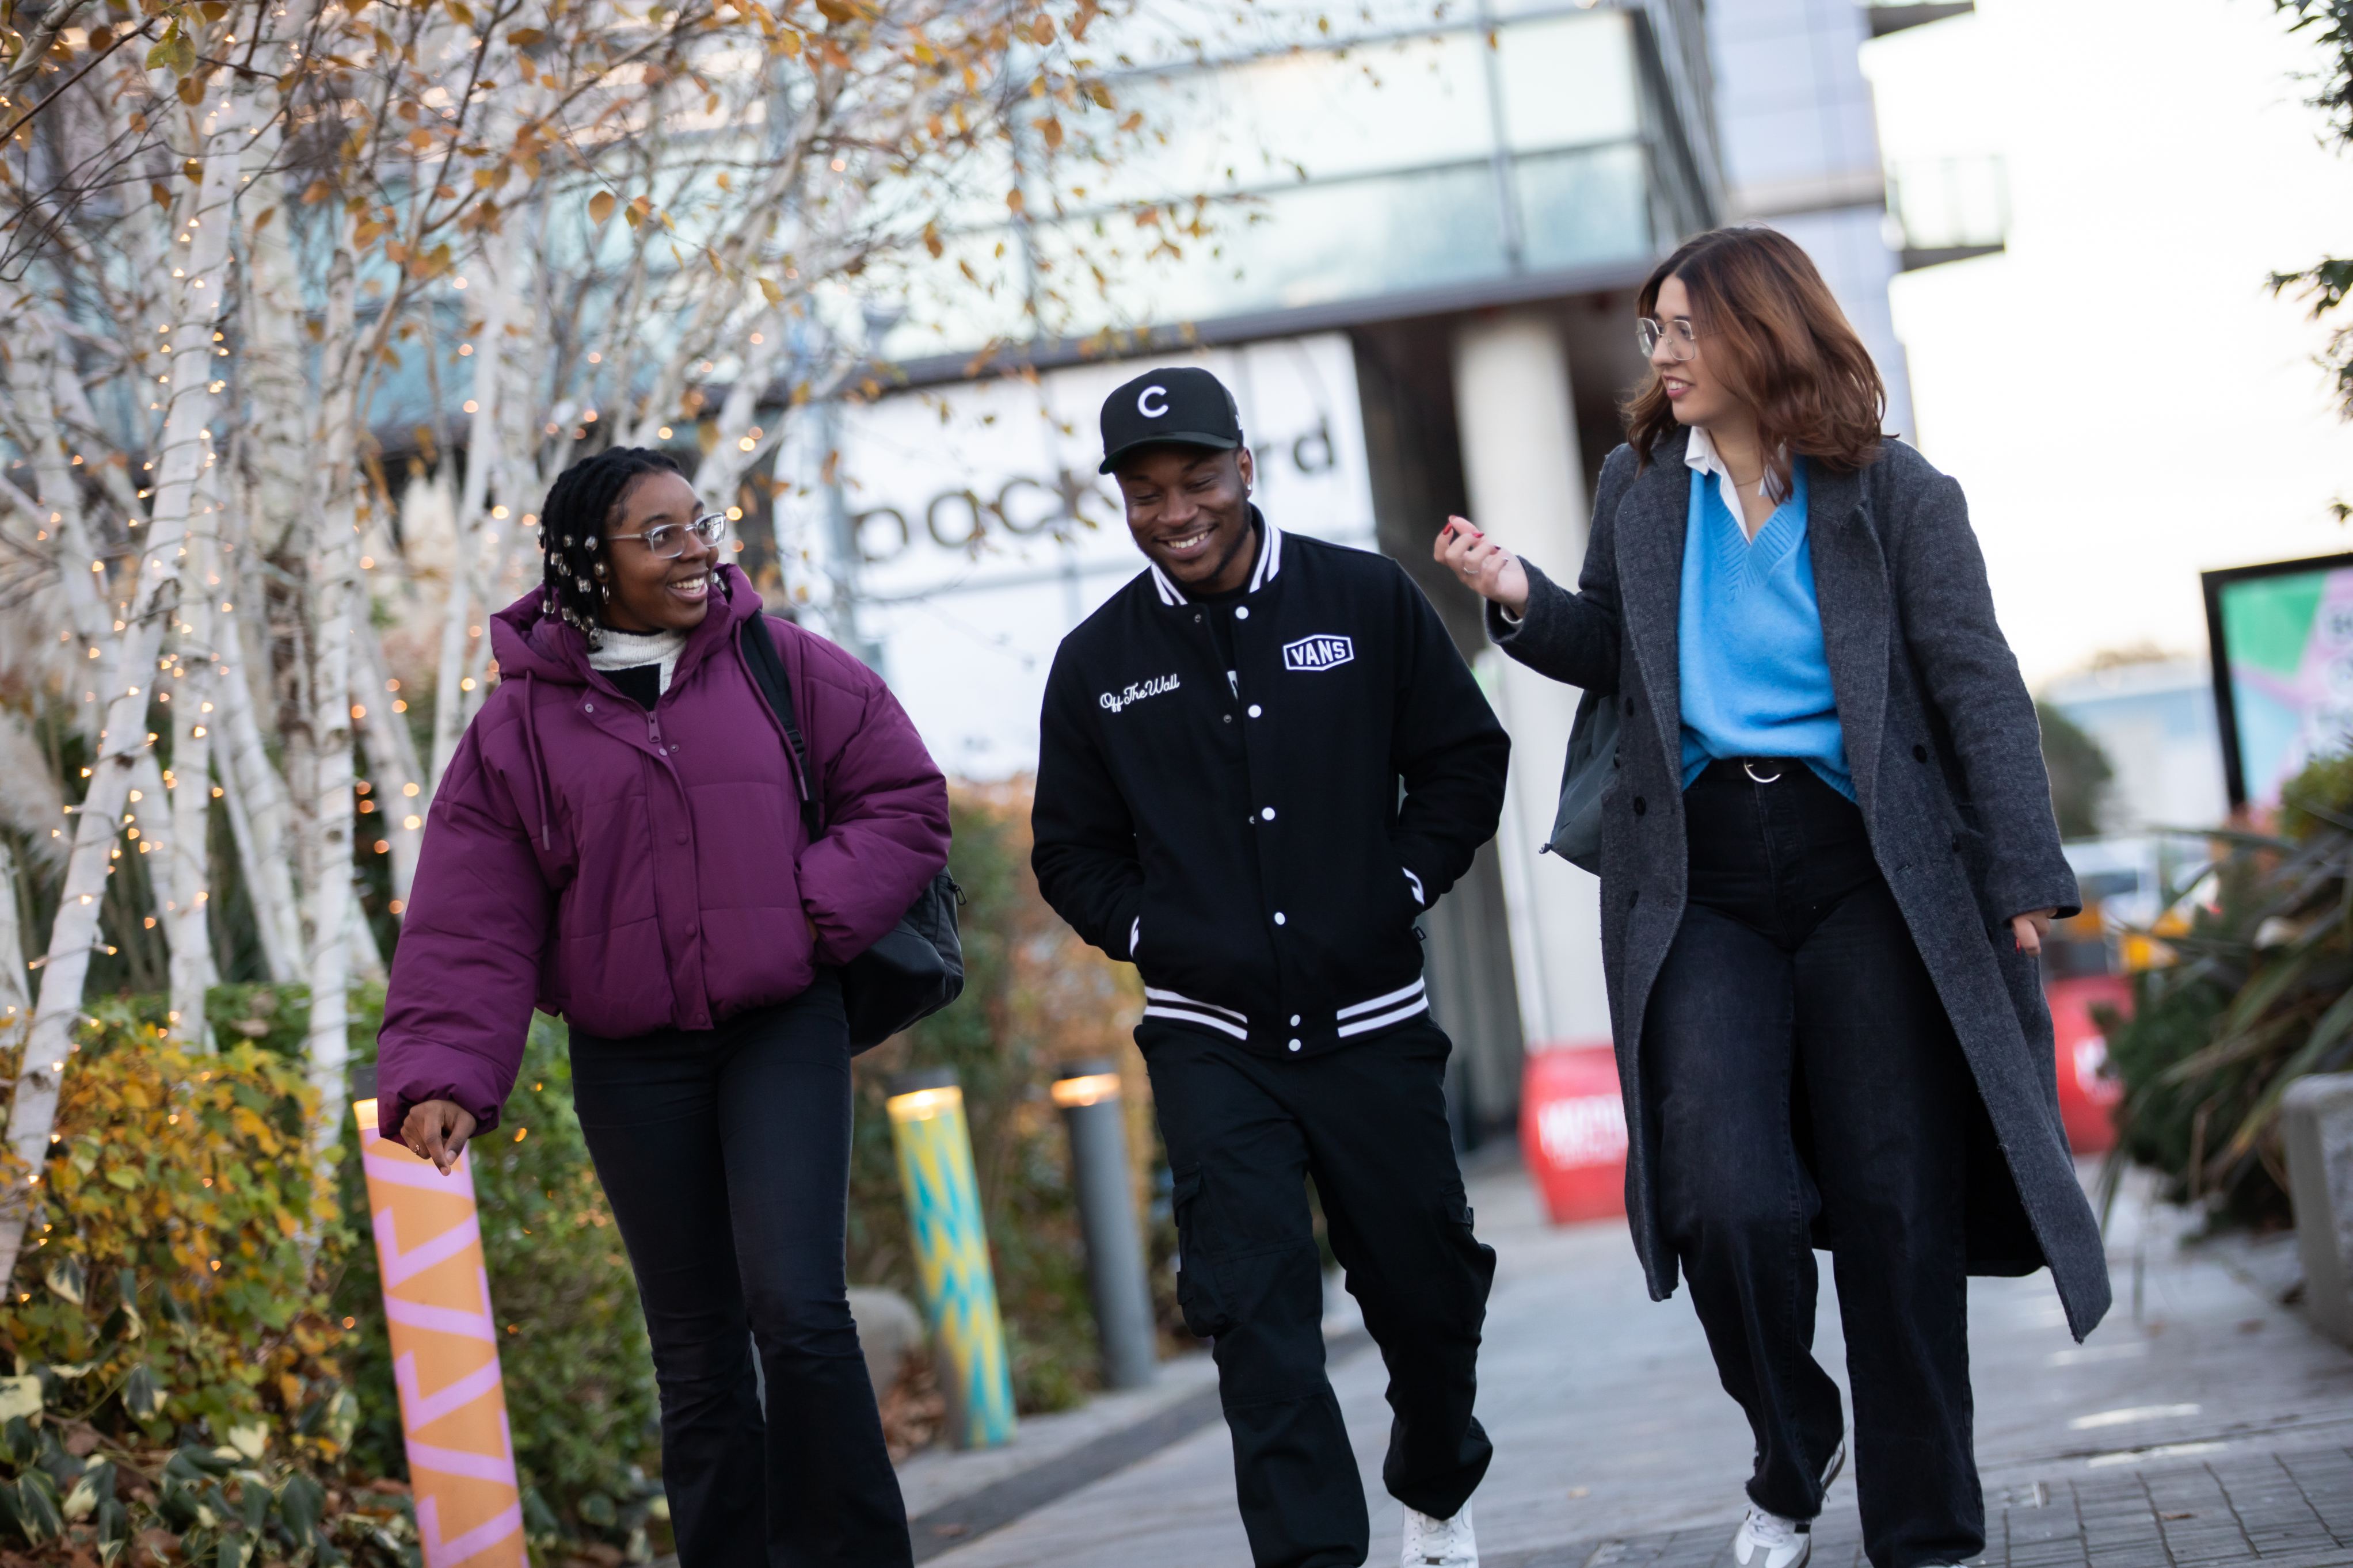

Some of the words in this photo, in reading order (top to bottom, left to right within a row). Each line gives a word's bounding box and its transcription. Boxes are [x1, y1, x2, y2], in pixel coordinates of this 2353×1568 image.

[1137, 385, 1169, 418] C
[1291, 640, 1346, 665] VANS
[1099, 692, 1123, 712] Off
[1124, 682, 1148, 705] The
[1144, 673, 1180, 696] Wall
